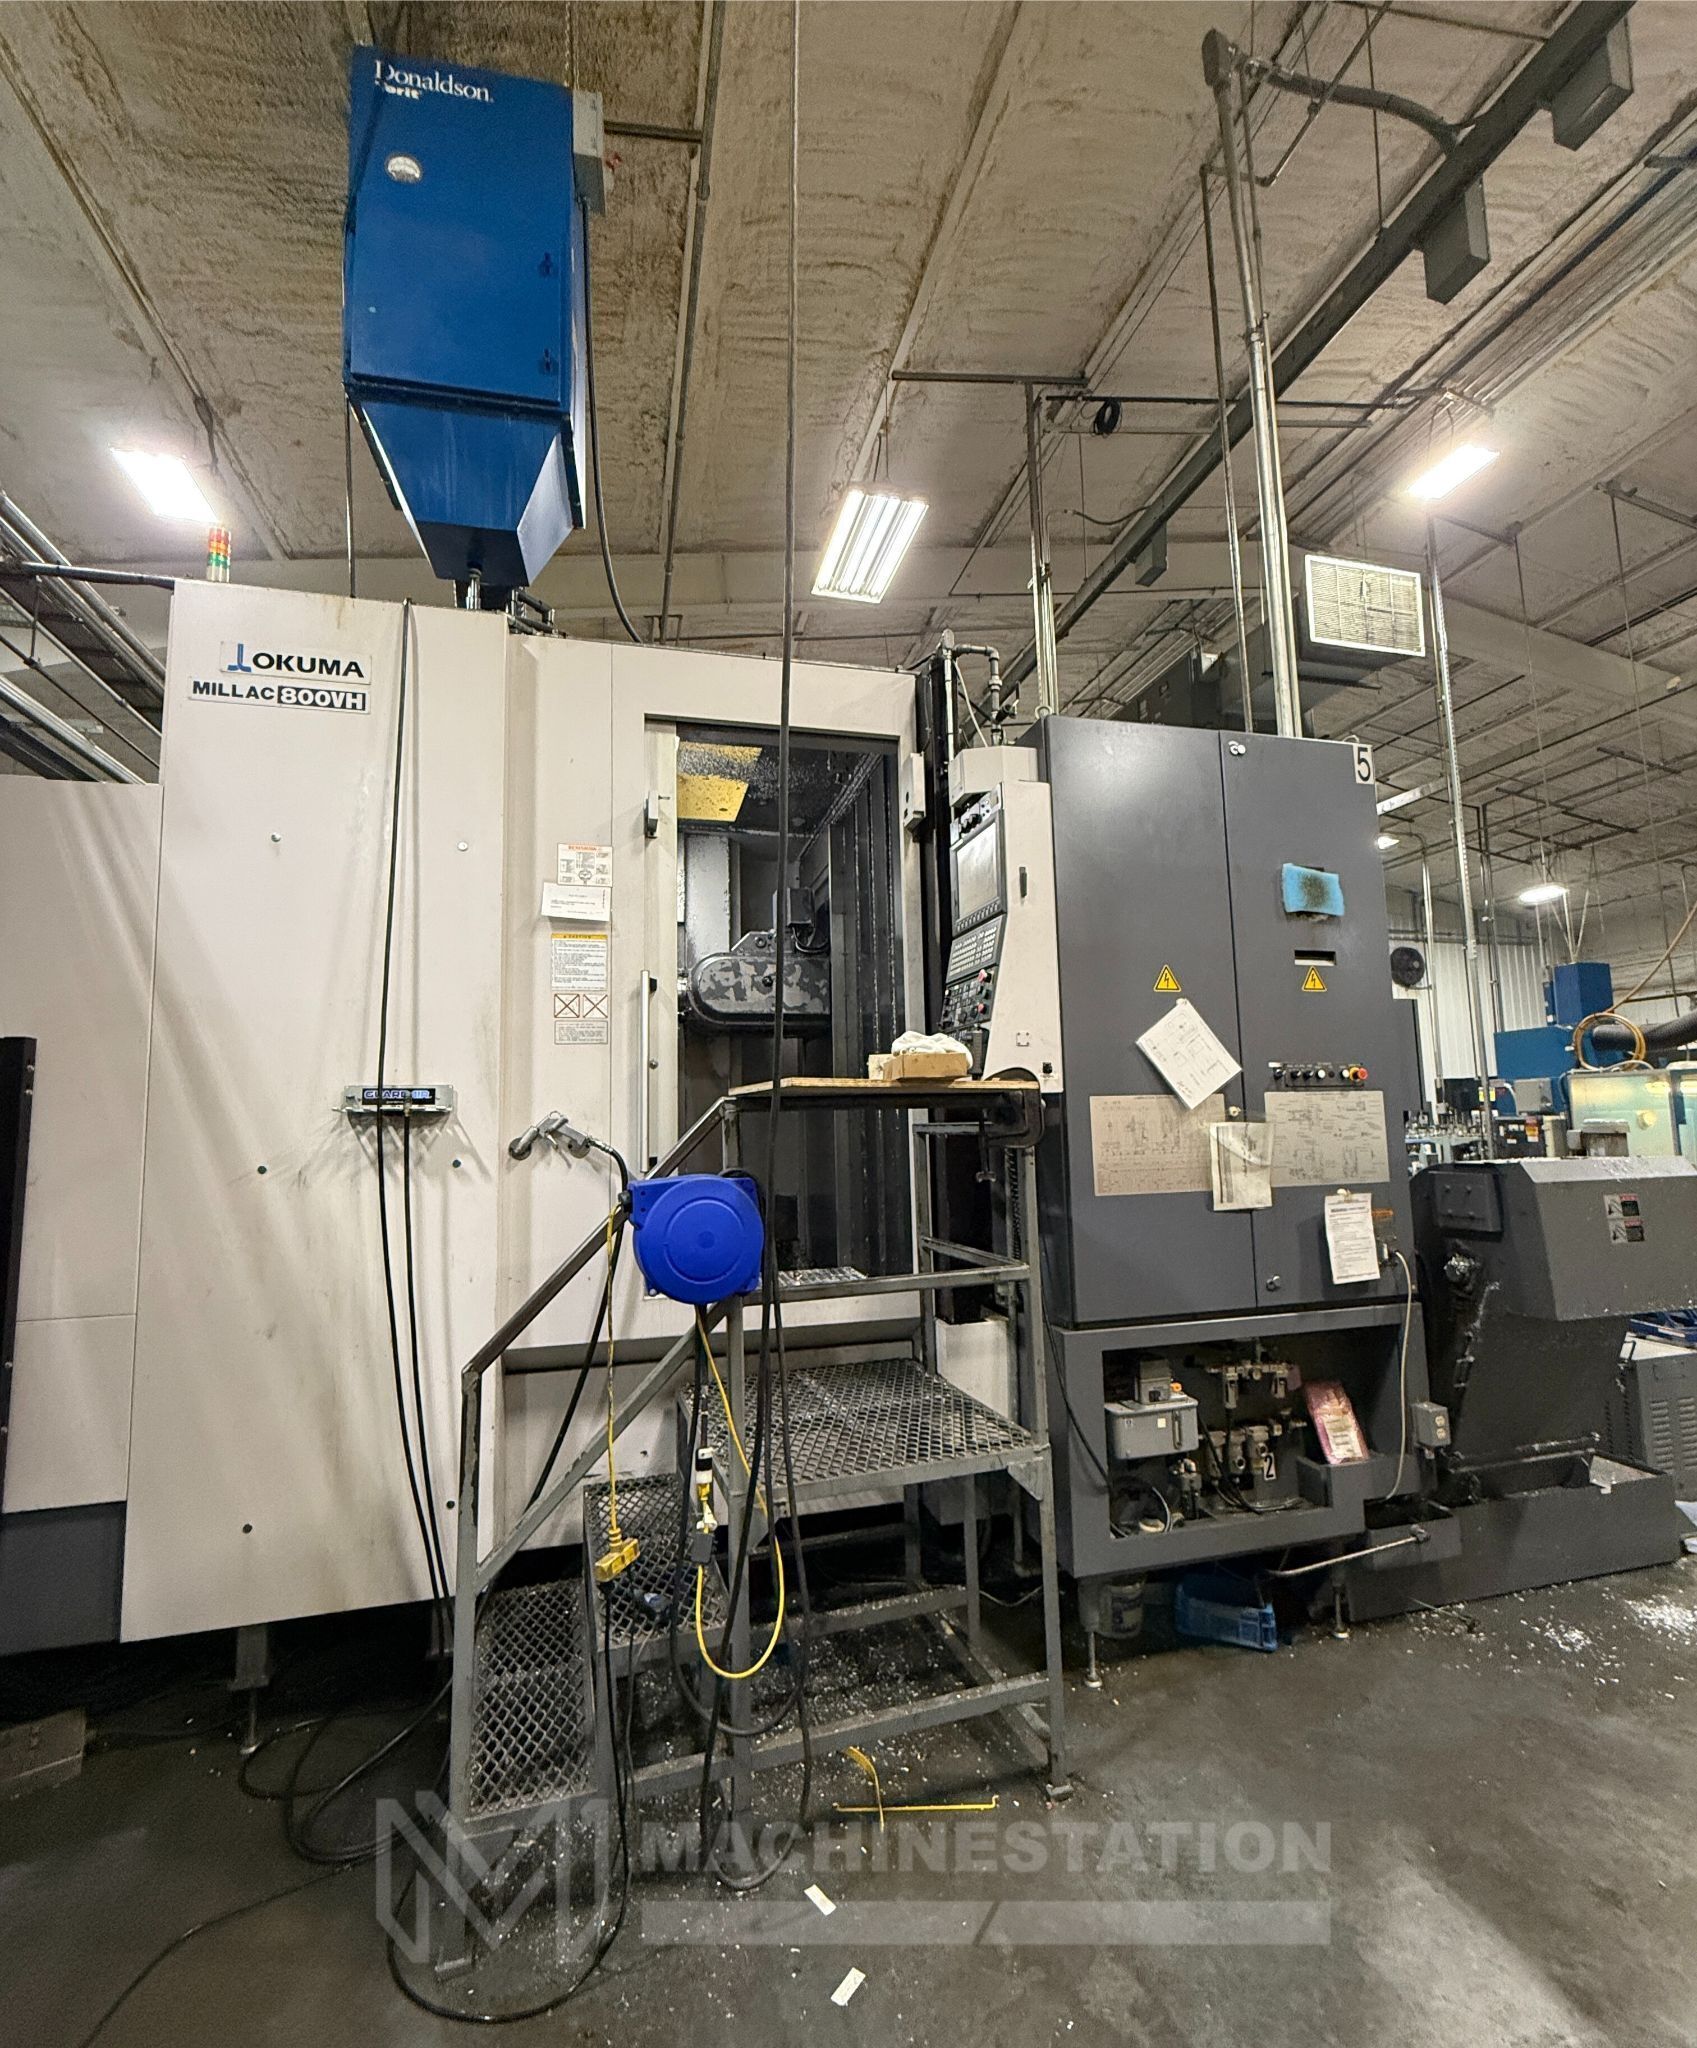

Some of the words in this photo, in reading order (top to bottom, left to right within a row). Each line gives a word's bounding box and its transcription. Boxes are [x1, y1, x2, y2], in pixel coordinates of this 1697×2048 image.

[252, 652, 365, 678] OKUMA
[192, 680, 275, 700] MILLAC
[279, 687, 364, 711] 800VH
[1357, 746, 1371, 782] 5
[1264, 1454, 1274, 1479] 2
